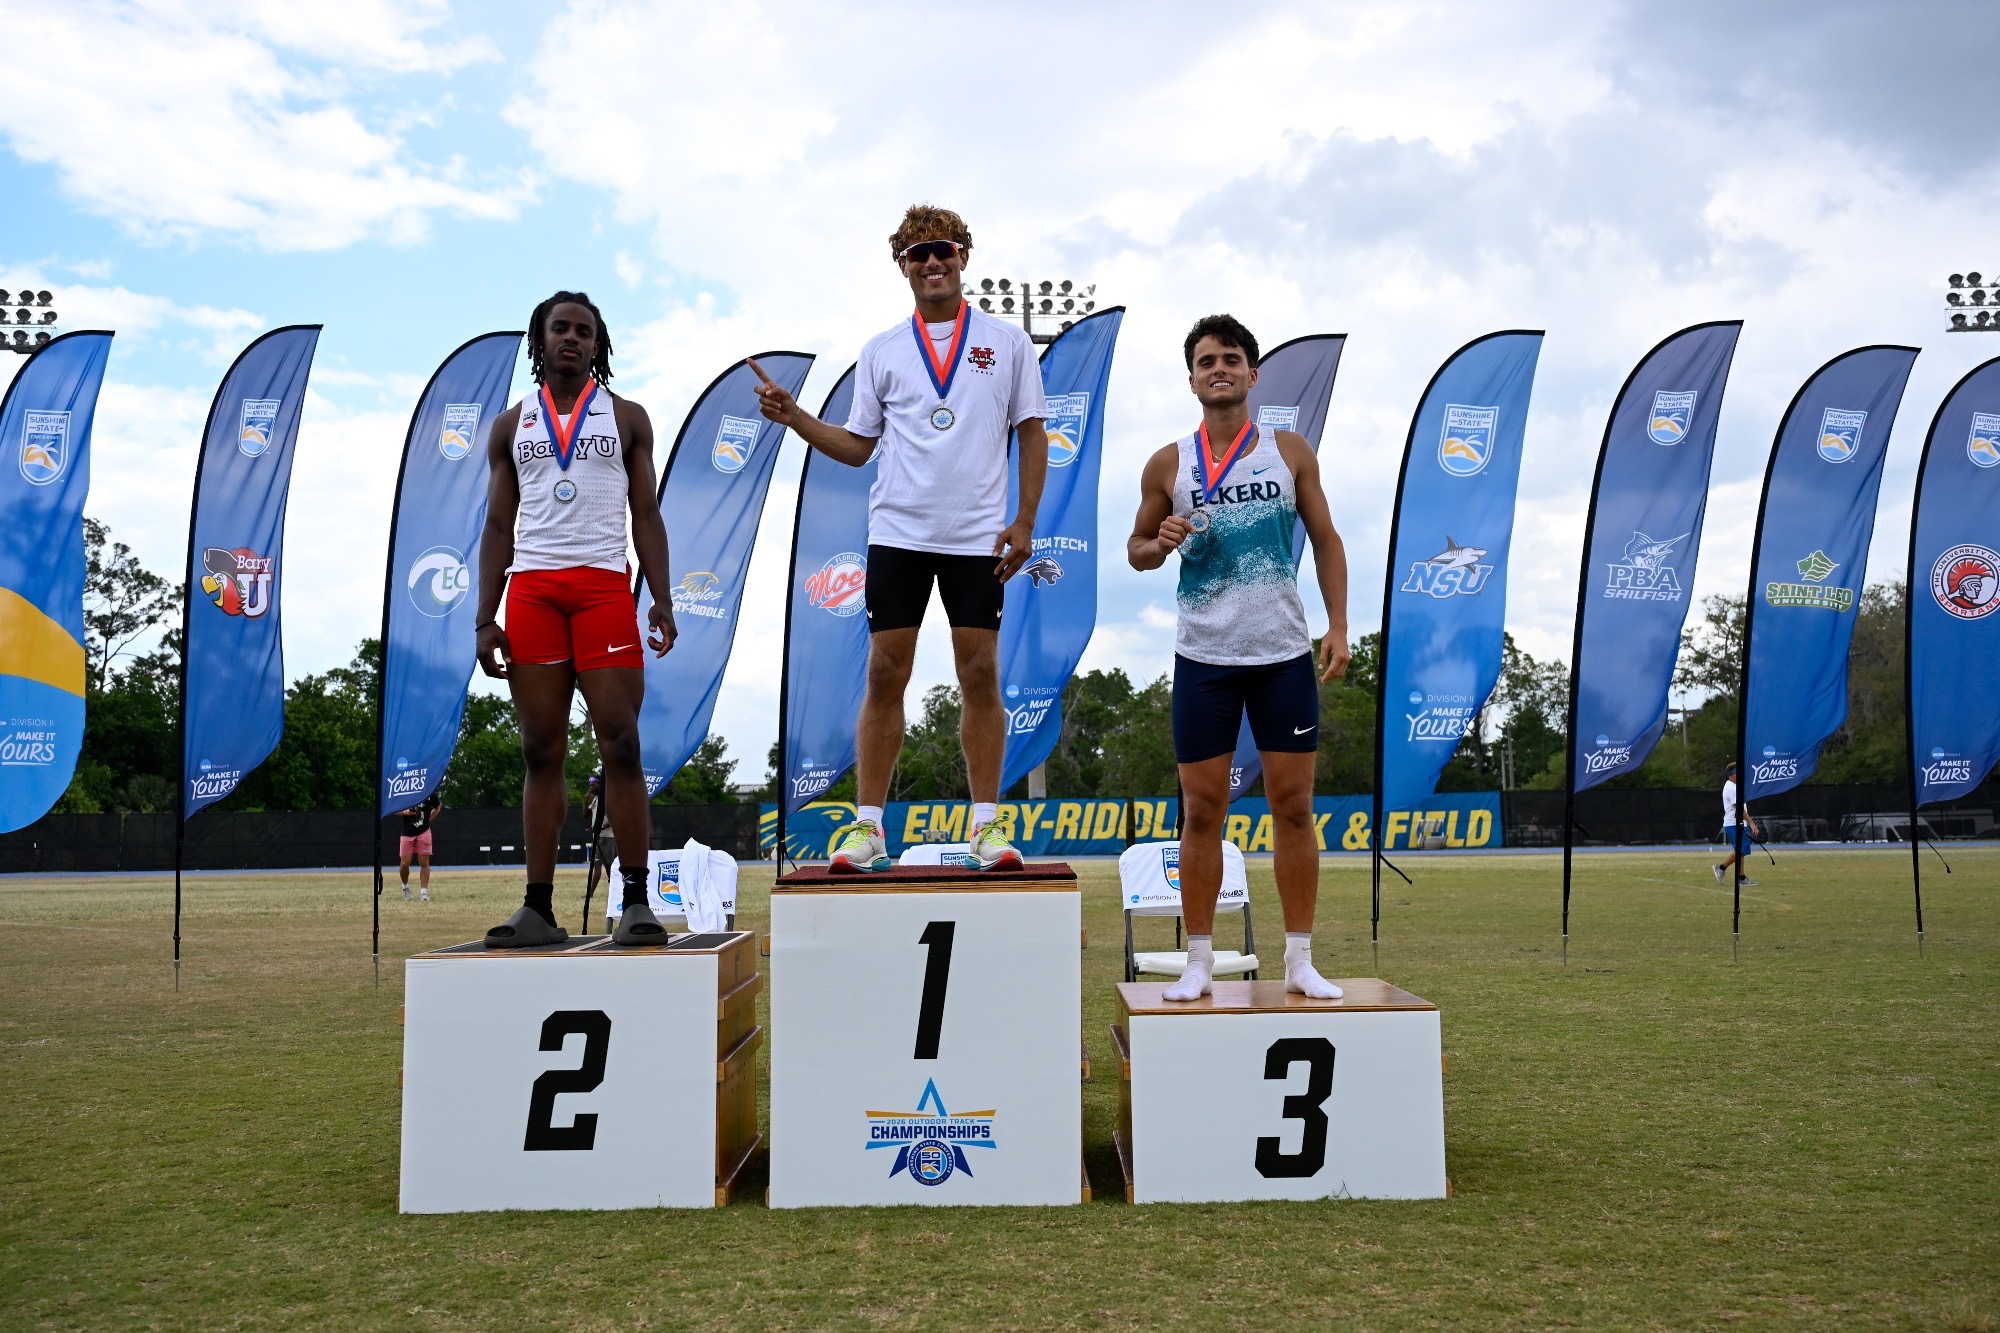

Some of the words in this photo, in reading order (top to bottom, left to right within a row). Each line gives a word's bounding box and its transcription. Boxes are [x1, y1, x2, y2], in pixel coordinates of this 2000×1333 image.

[971, 356, 994, 365] TAMPA
[1048, 399, 1083, 409] SUNHINE
[1056, 407, 1074, 416] SATE
[1451, 410, 1492, 418] SUNSHINE
[1458, 418, 1481, 426] STATE
[1977, 417, 2000, 425] SUNSH
[1054, 536, 1088, 552] TECH
[835, 554, 861, 564] FLORIDA
[1938, 548, 1986, 570] UNIVERSITY
[1988, 554, 1999, 563] OF
[442, 566, 469, 590] EC
[805, 564, 866, 606] Moc
[1400, 561, 1496, 599] NSU
[1606, 563, 1682, 591] PBA
[237, 573, 272, 616] U
[670, 586, 724, 606] Eagles
[1603, 588, 1682, 602] SAILFISH
[1766, 582, 1822, 599] SAINT
[1824, 586, 1854, 605] LEO
[1773, 598, 1844, 610] UNIVERSITY
[673, 601, 725, 619] RY-RIDDLE
[1938, 593, 2000, 616] SPARTANS
[1427, 694, 1466, 702] DIVISION
[11, 718, 47, 726] DIVISION
[1004, 703, 1048, 736] YOU
[1432, 708, 1463, 717] MAKE
[1464, 708, 1473, 716] IT
[1406, 710, 1470, 741] YOURS
[16, 732, 44, 741] MAKE
[46, 732, 56, 741] IT
[1584, 750, 1630, 774] YOURS
[207, 772, 231, 780] MAKE
[232, 770, 241, 778] IT
[644, 774, 656, 783] KE
[809, 770, 830, 778] MAKE
[1752, 761, 1797, 785] YOURS
[1921, 763, 1970, 787] YOURS
[191, 775, 240, 801] YOURS
[387, 773, 427, 799] YOURS
[791, 773, 829, 799] YOUR
[902, 801, 1179, 843] EMRY-RIDDL
[1222, 812, 1333, 852] RAK
[1342, 811, 1372, 851] &
[914, 921, 955, 1059] 1
[524, 1010, 611, 1151] 2
[1255, 1038, 1336, 1178] 3
[871, 1125, 991, 1140] CHAMPIONSHIPS
[909, 1147, 920, 1175] SUNSHINE
[936, 1142, 953, 1174] CONFERENCE
[921, 1151, 941, 1159] 50
